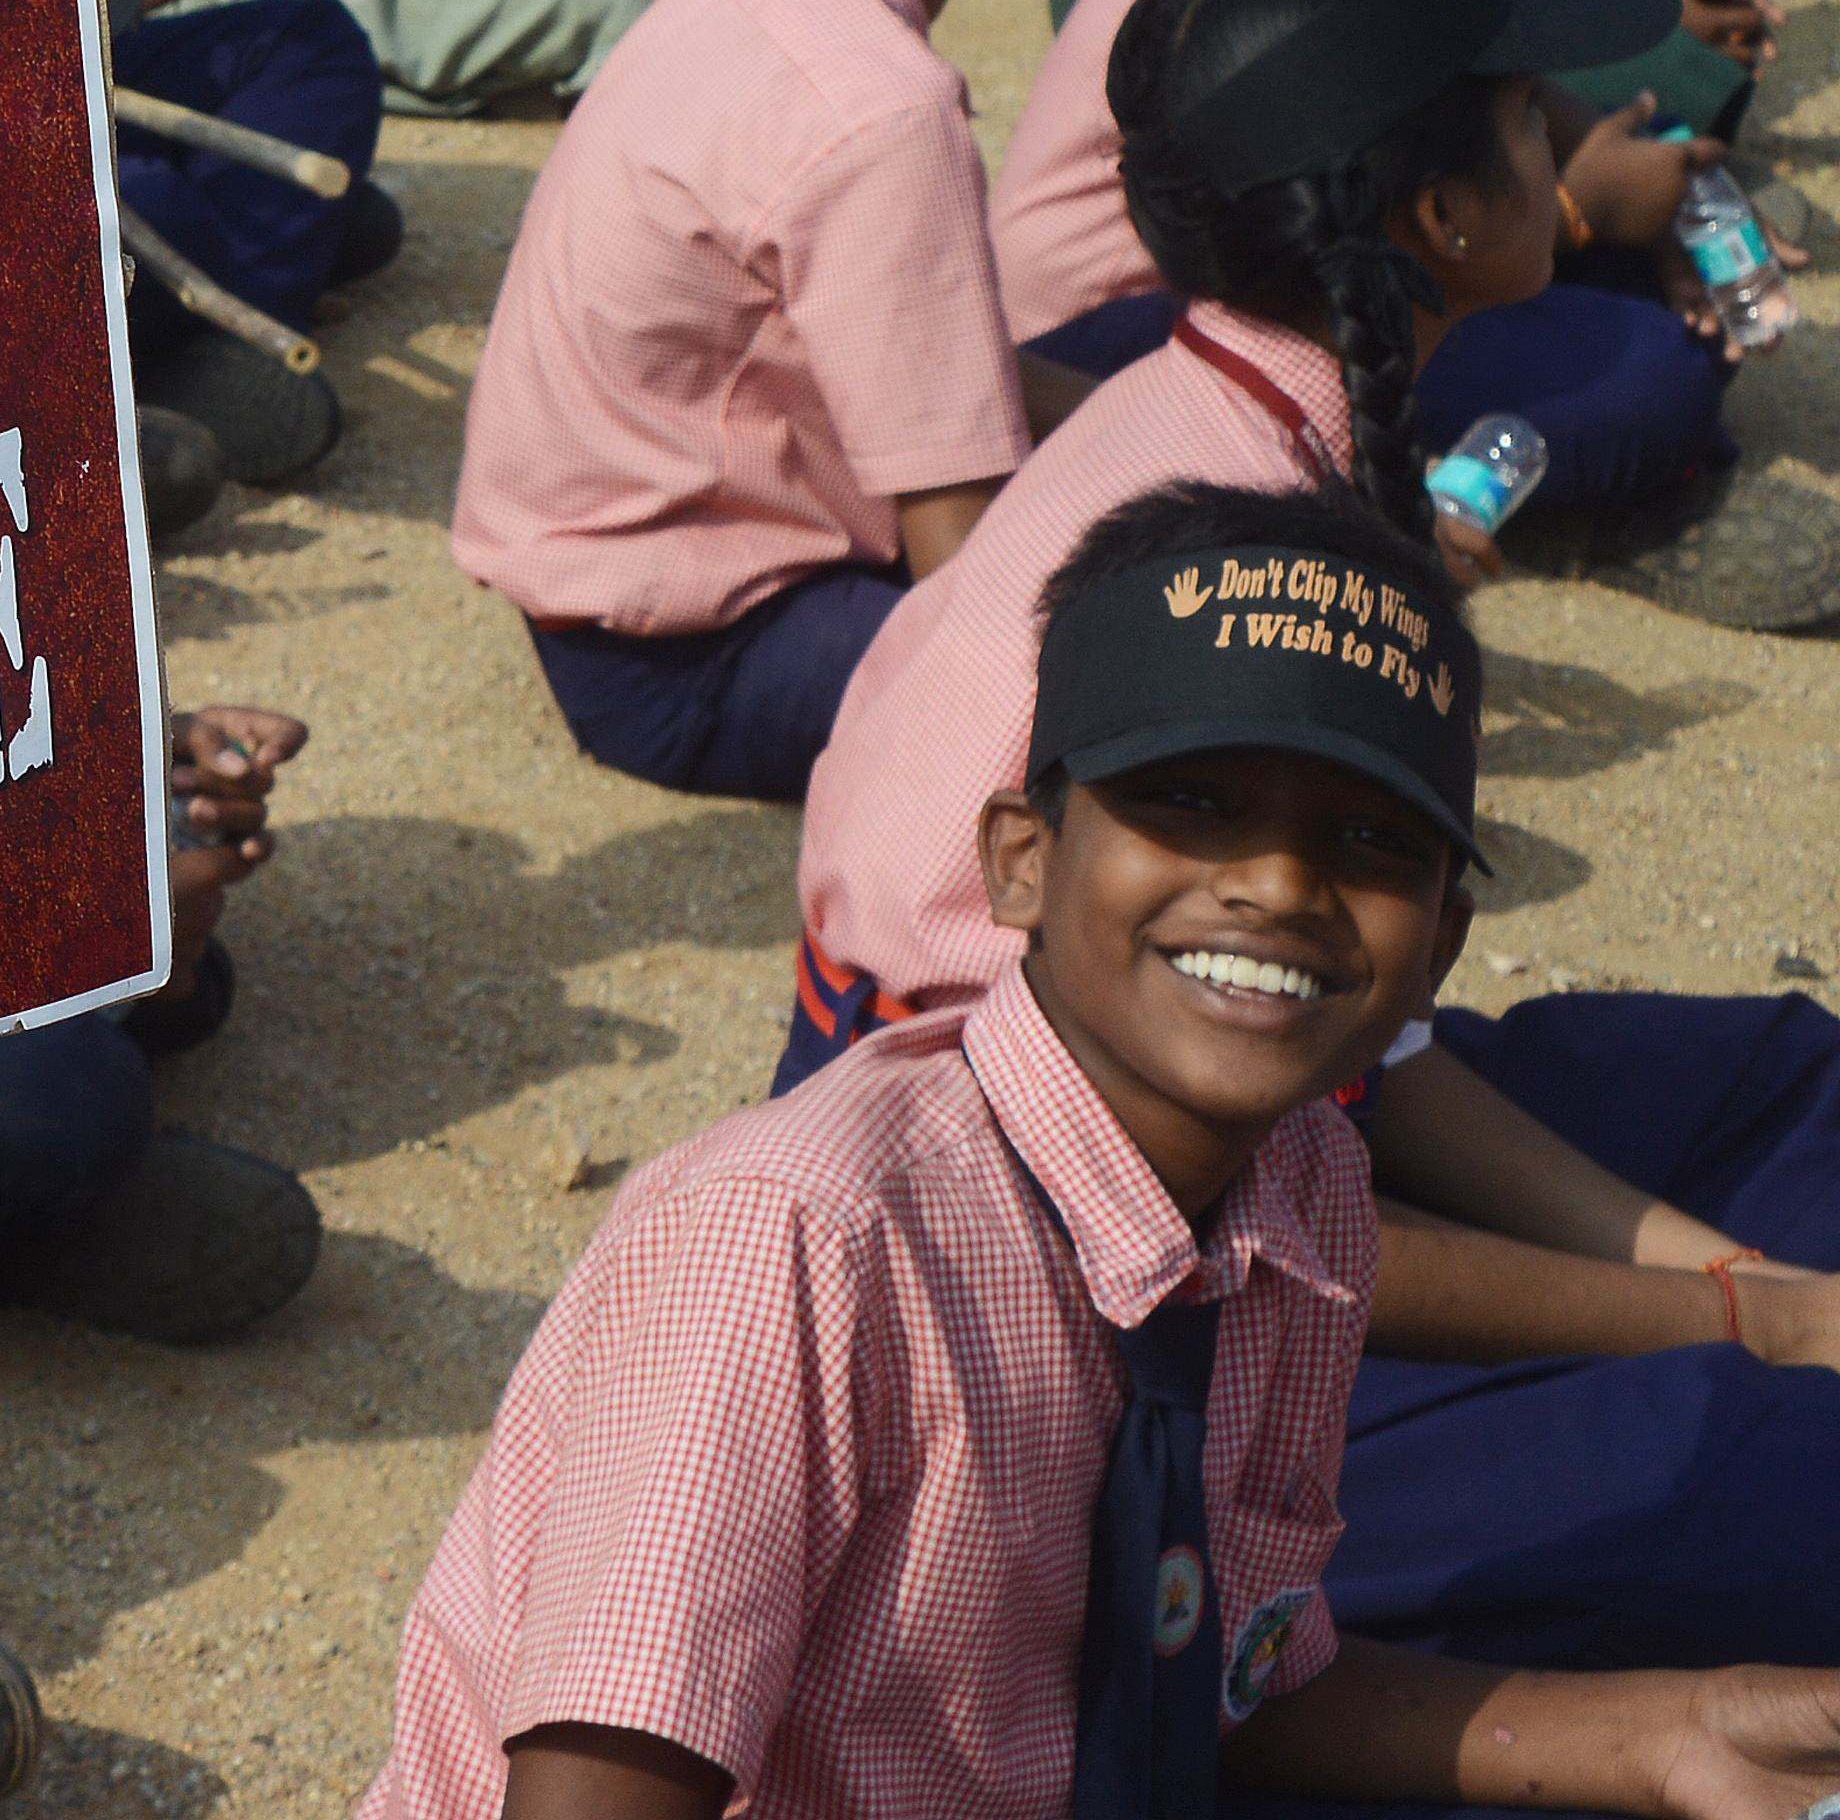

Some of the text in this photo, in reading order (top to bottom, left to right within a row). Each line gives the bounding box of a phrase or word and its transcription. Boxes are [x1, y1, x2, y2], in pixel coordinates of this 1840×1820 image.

[1217, 557, 1284, 601] Don't
[1287, 558, 1337, 615] Clip
[1339, 569, 1374, 627] My
[1215, 612, 1422, 700] I Wish to Fly
